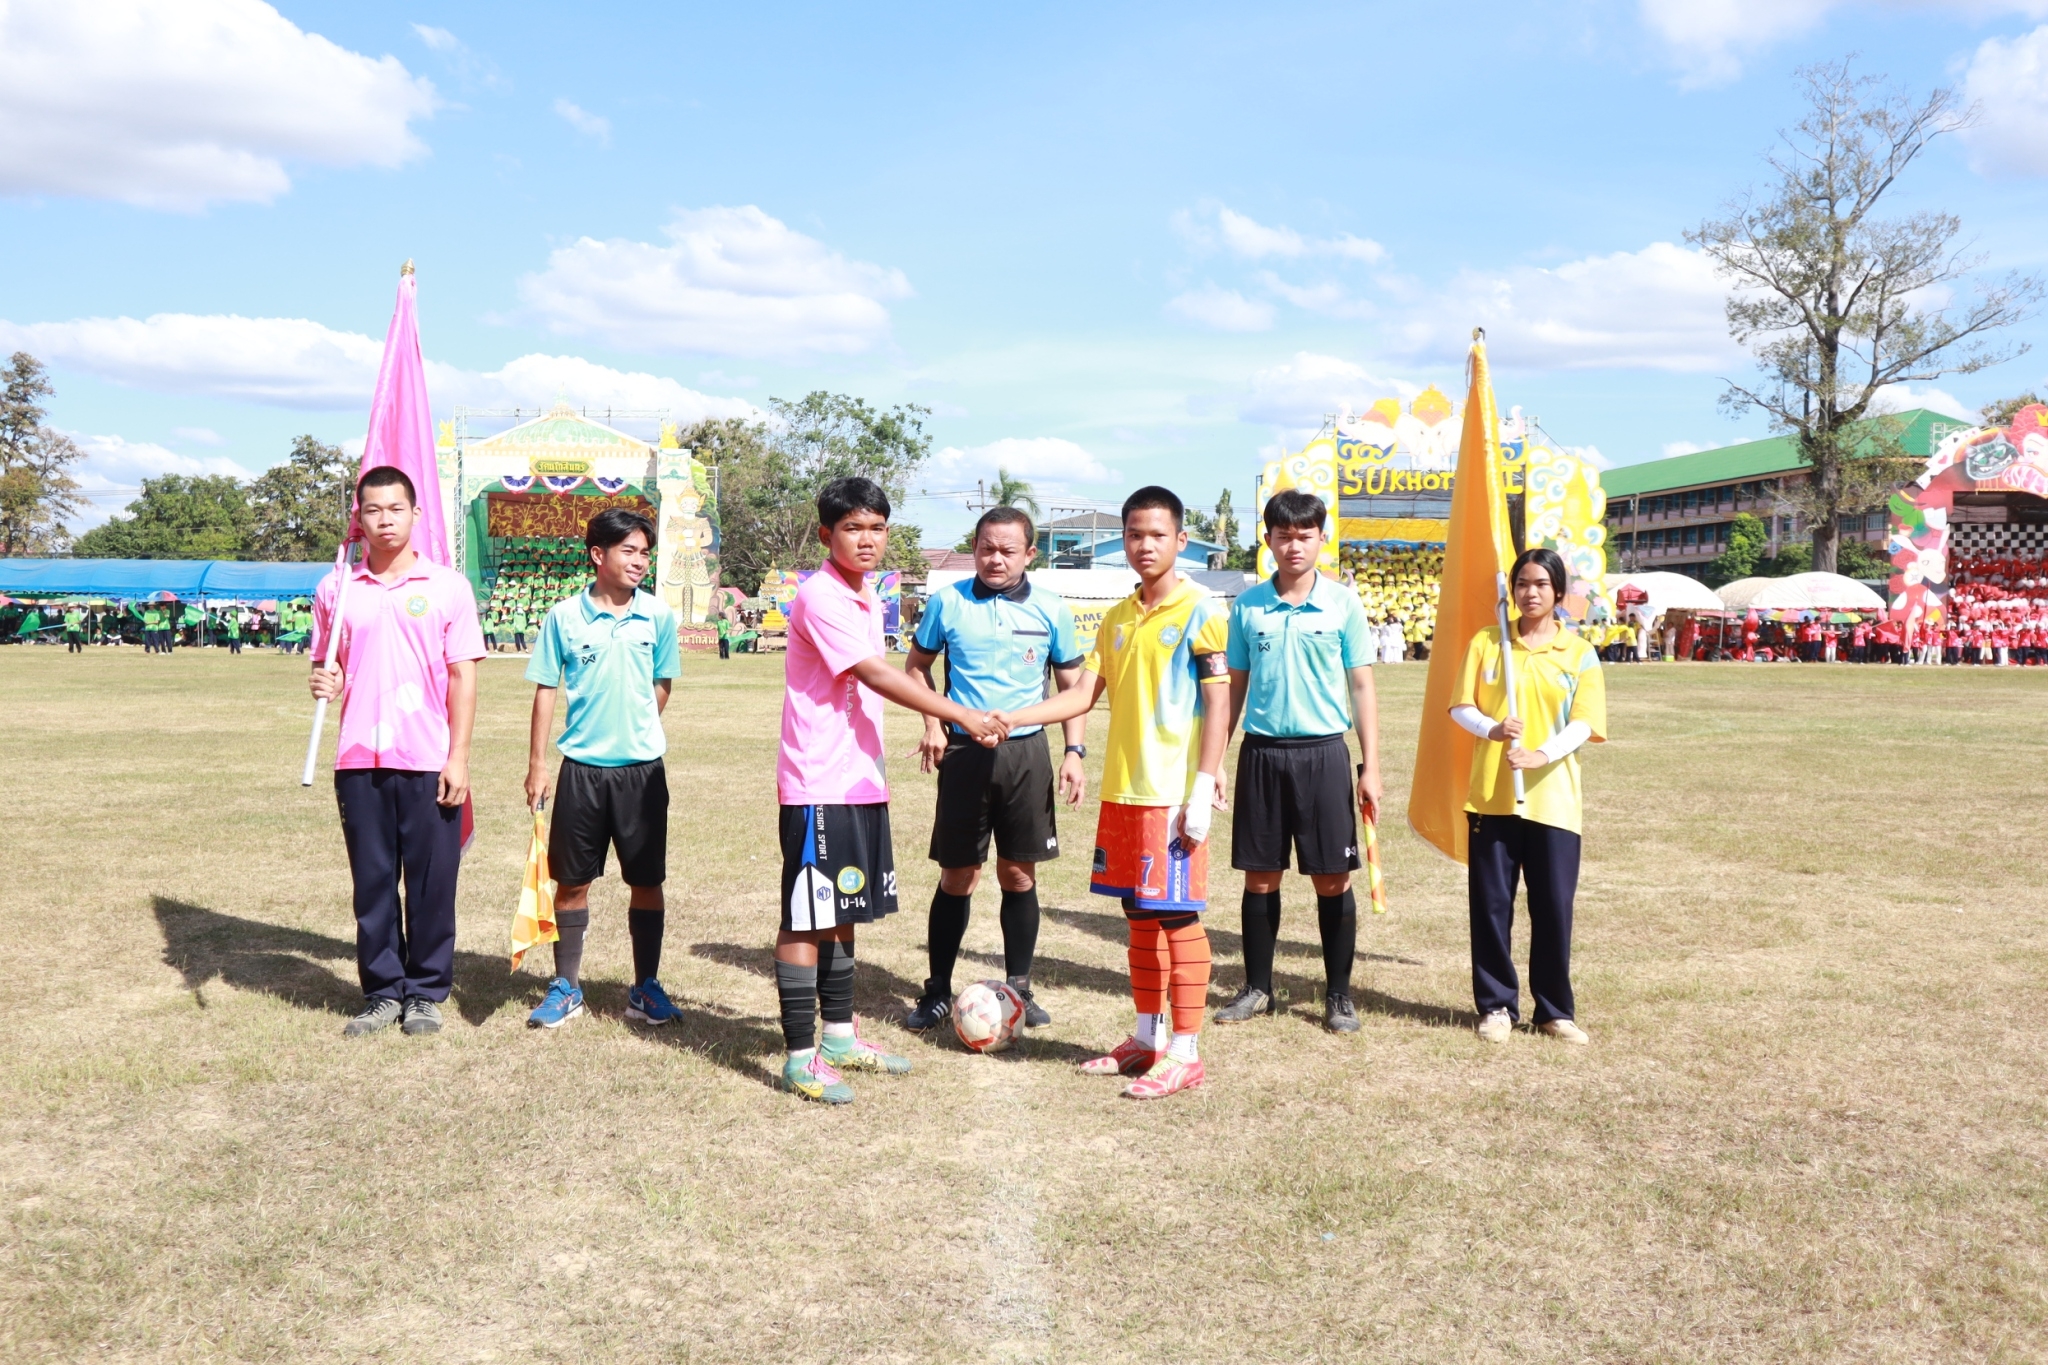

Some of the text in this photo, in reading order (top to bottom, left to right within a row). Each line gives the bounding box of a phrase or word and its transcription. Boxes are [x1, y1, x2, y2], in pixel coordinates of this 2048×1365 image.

[1343, 464, 1524, 495] SUKHOTI
[1074, 612, 1103, 622] AME
[816, 805, 827, 860] ESIGN SPORT
[1140, 856, 1154, 887] 7
[840, 897, 866, 910] U-14
